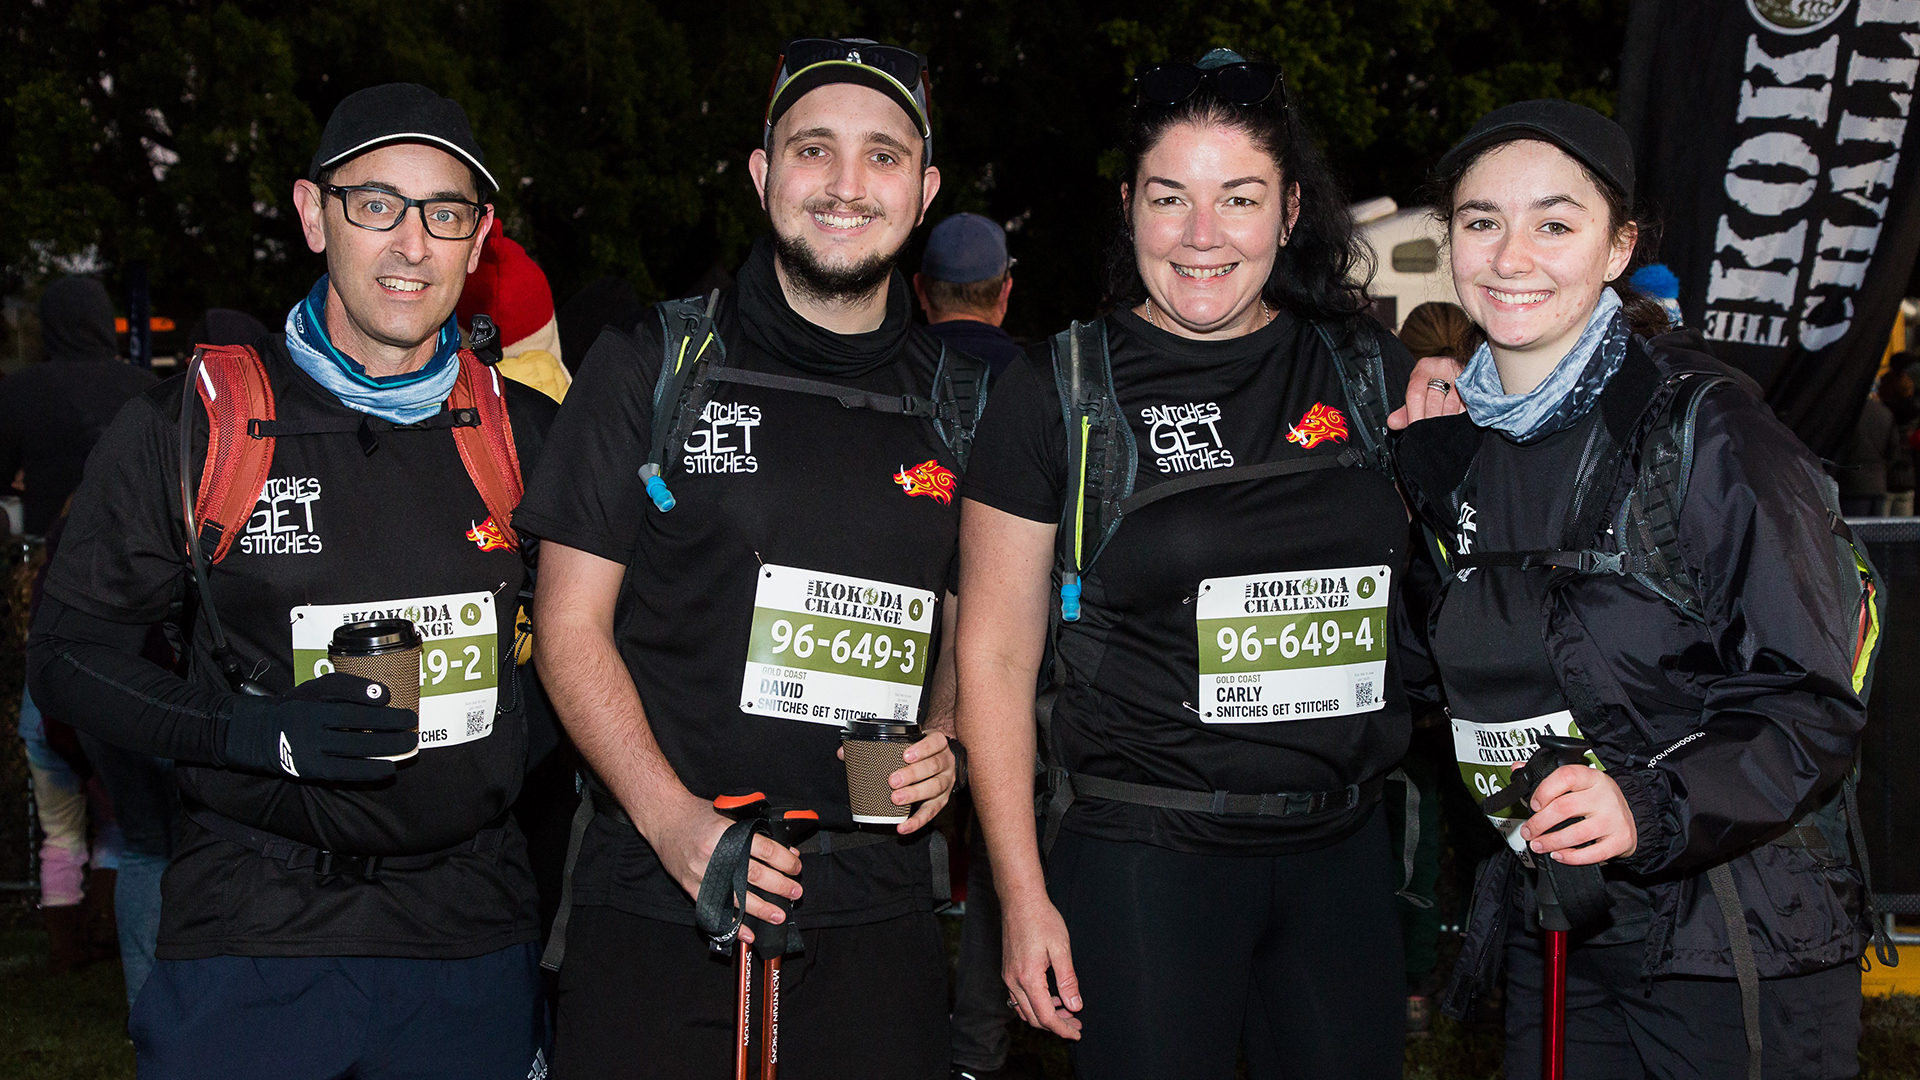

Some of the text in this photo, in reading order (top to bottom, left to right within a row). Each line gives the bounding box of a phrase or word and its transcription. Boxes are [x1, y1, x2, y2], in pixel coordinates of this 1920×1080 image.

[1703, 310, 1789, 347] THE
[1141, 402, 1221, 425] SNITCHES
[684, 420, 760, 457] GET
[1150, 415, 1223, 456] GET
[683, 452, 758, 473] STITCHES
[1156, 448, 1235, 473] STITCHES
[246, 494, 320, 538] GET
[240, 531, 322, 554] STITCHES
[1362, 582, 1370, 593] 4
[466, 608, 475, 621] 4
[805, 597, 902, 625] CHALLENGE
[913, 603, 919, 616] 4
[1244, 595, 1349, 613] CHALLENGE
[771, 619, 916, 674] 96-649-3
[1216, 617, 1374, 663] 96-649-4
[762, 666, 807, 680] GOLD COAST
[1216, 674, 1261, 684] GOLD COAST
[760, 678, 803, 698] DAVID
[1216, 686, 1262, 702] CARLY
[757, 697, 808, 716] SNITCHES
[812, 705, 830, 718] GET
[1216, 699, 1340, 718] SNITCHES GET STITCHES
[743, 994, 751, 1046] MOUNTAIN
[770, 969, 780, 1065] MOUNTAIN DESIGNS
